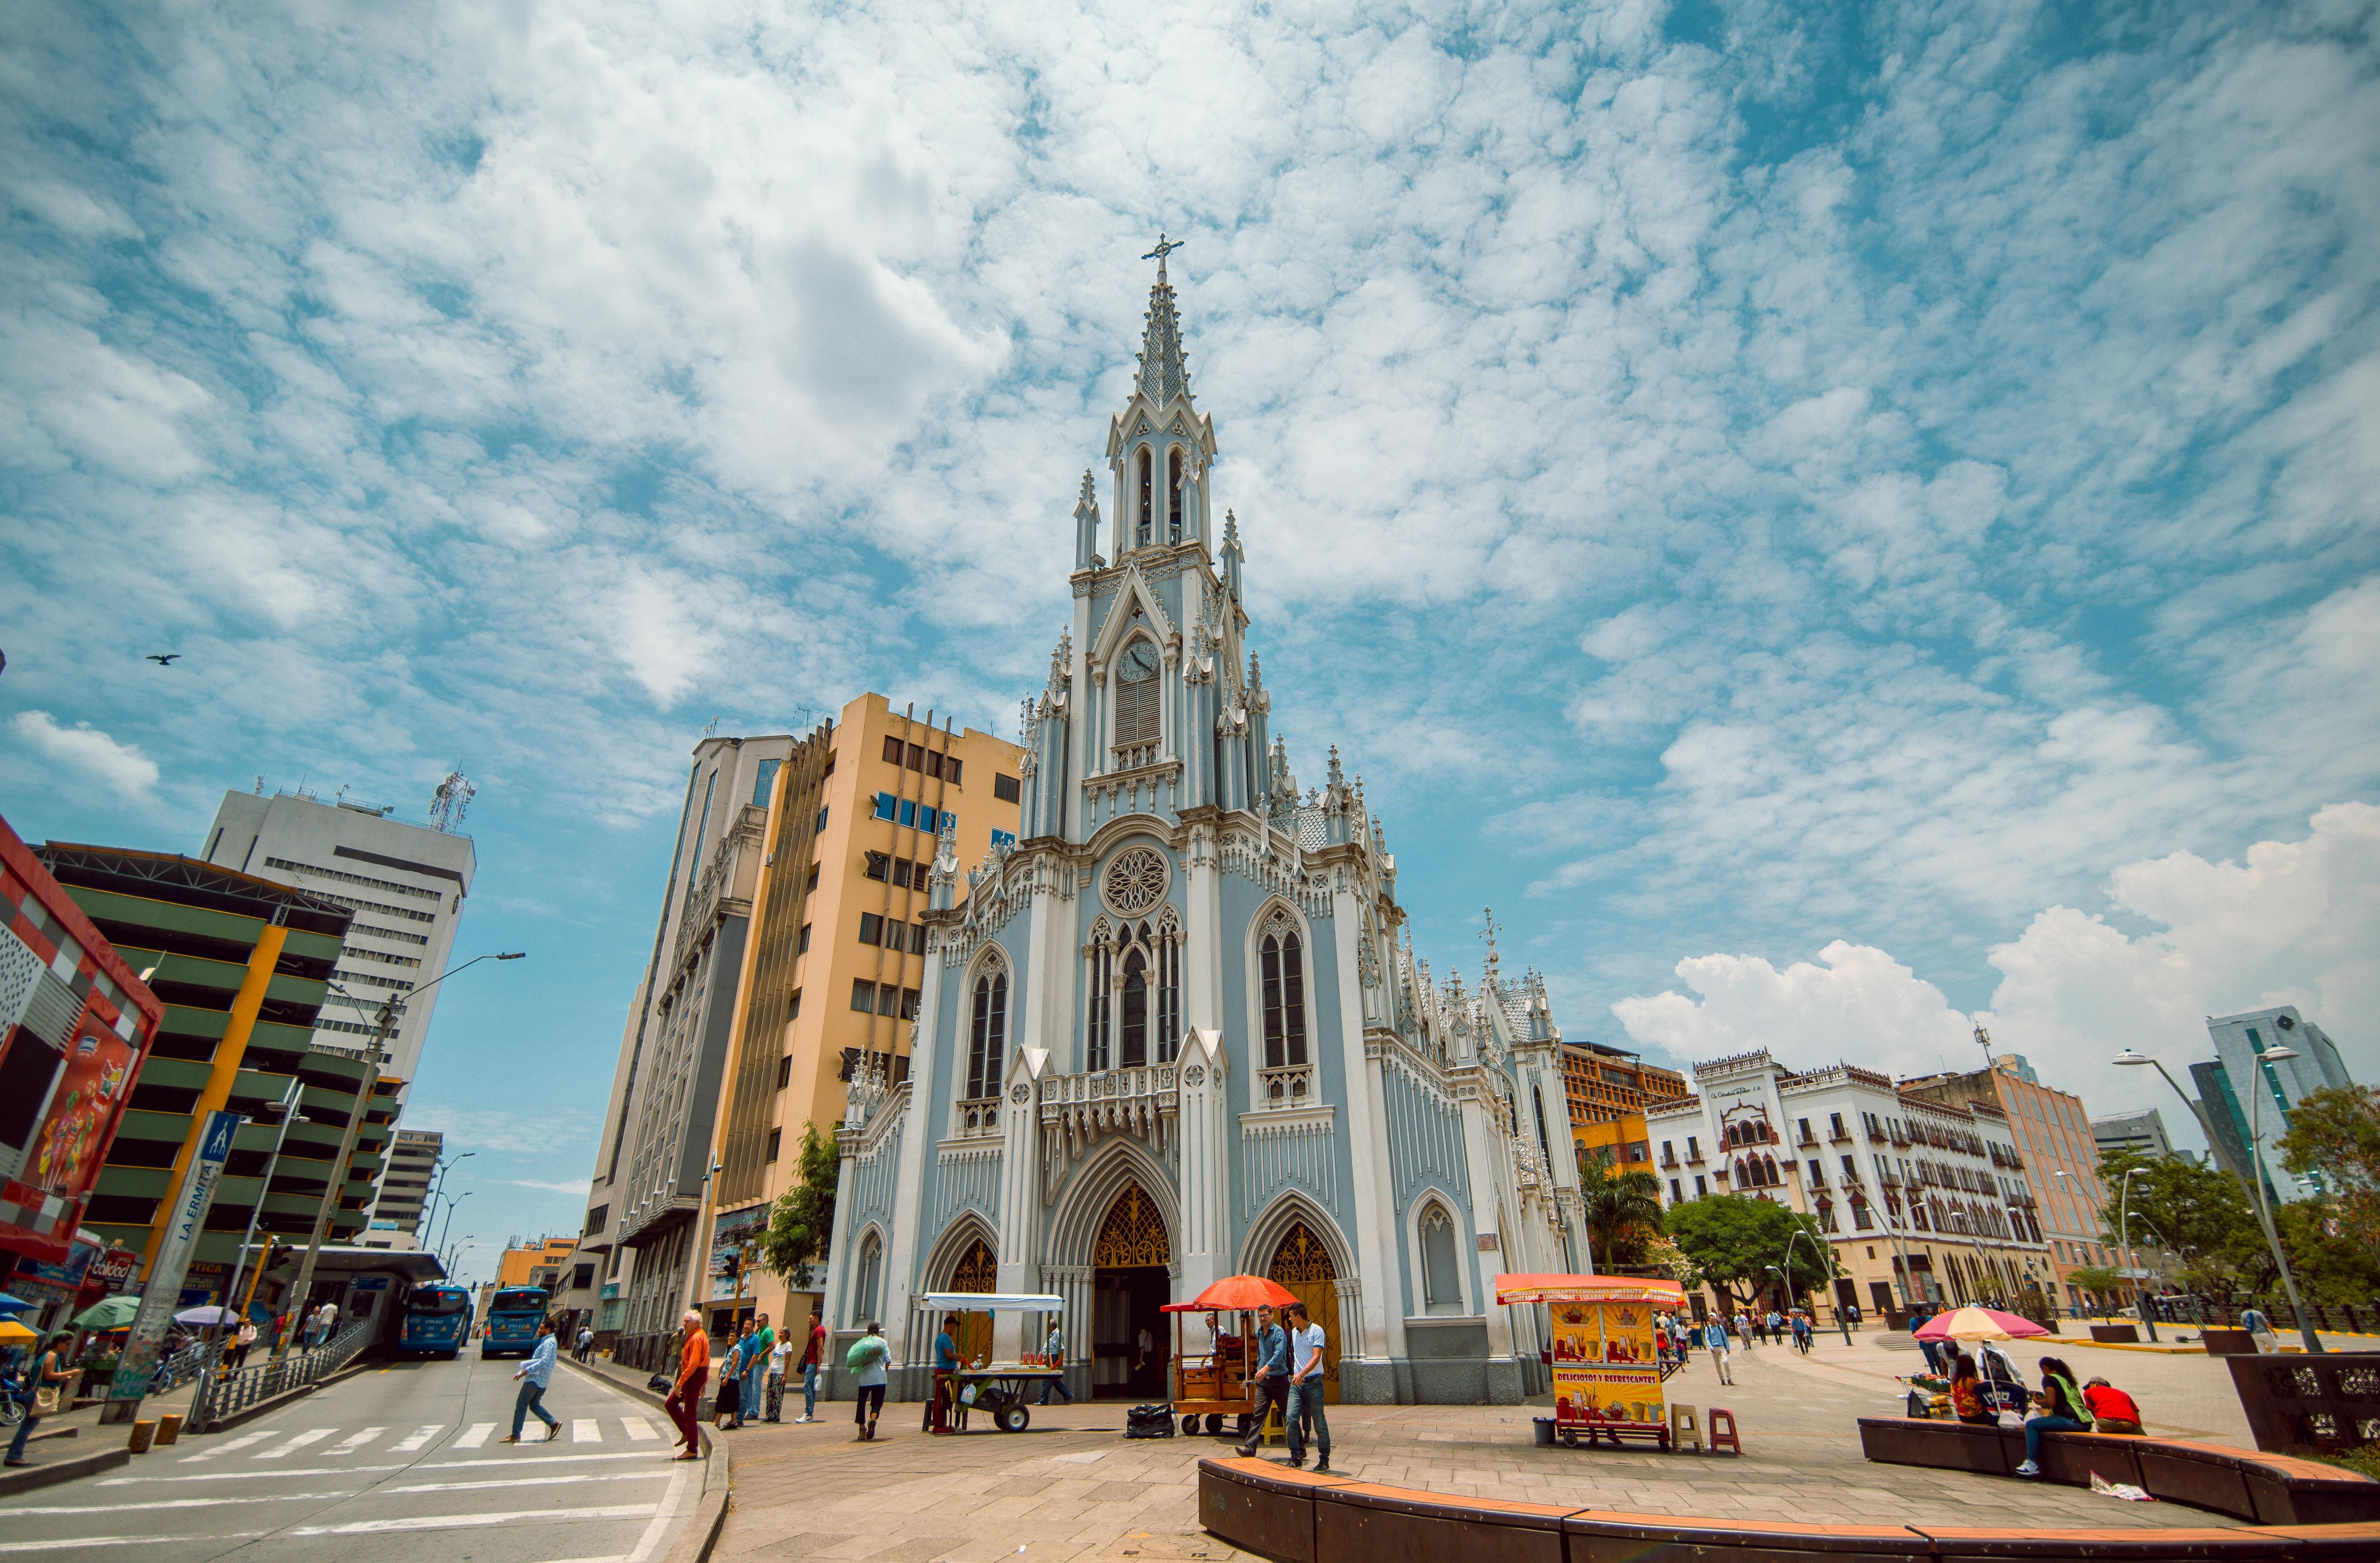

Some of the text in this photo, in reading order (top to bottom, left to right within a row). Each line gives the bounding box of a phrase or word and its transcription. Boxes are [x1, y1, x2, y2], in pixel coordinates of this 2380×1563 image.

[179, 1165, 213, 1240] LA ERMITA
[93, 1261, 130, 1278] calidad
[190, 1263, 223, 1273] PTICA
[1649, 1289, 1681, 1297] RASPADOS
[1653, 1294, 1677, 1303] FRUTAS
[1557, 1373, 1597, 1382] DELICIOSOS
[1604, 1374, 1656, 1384] REFRESCANTES
